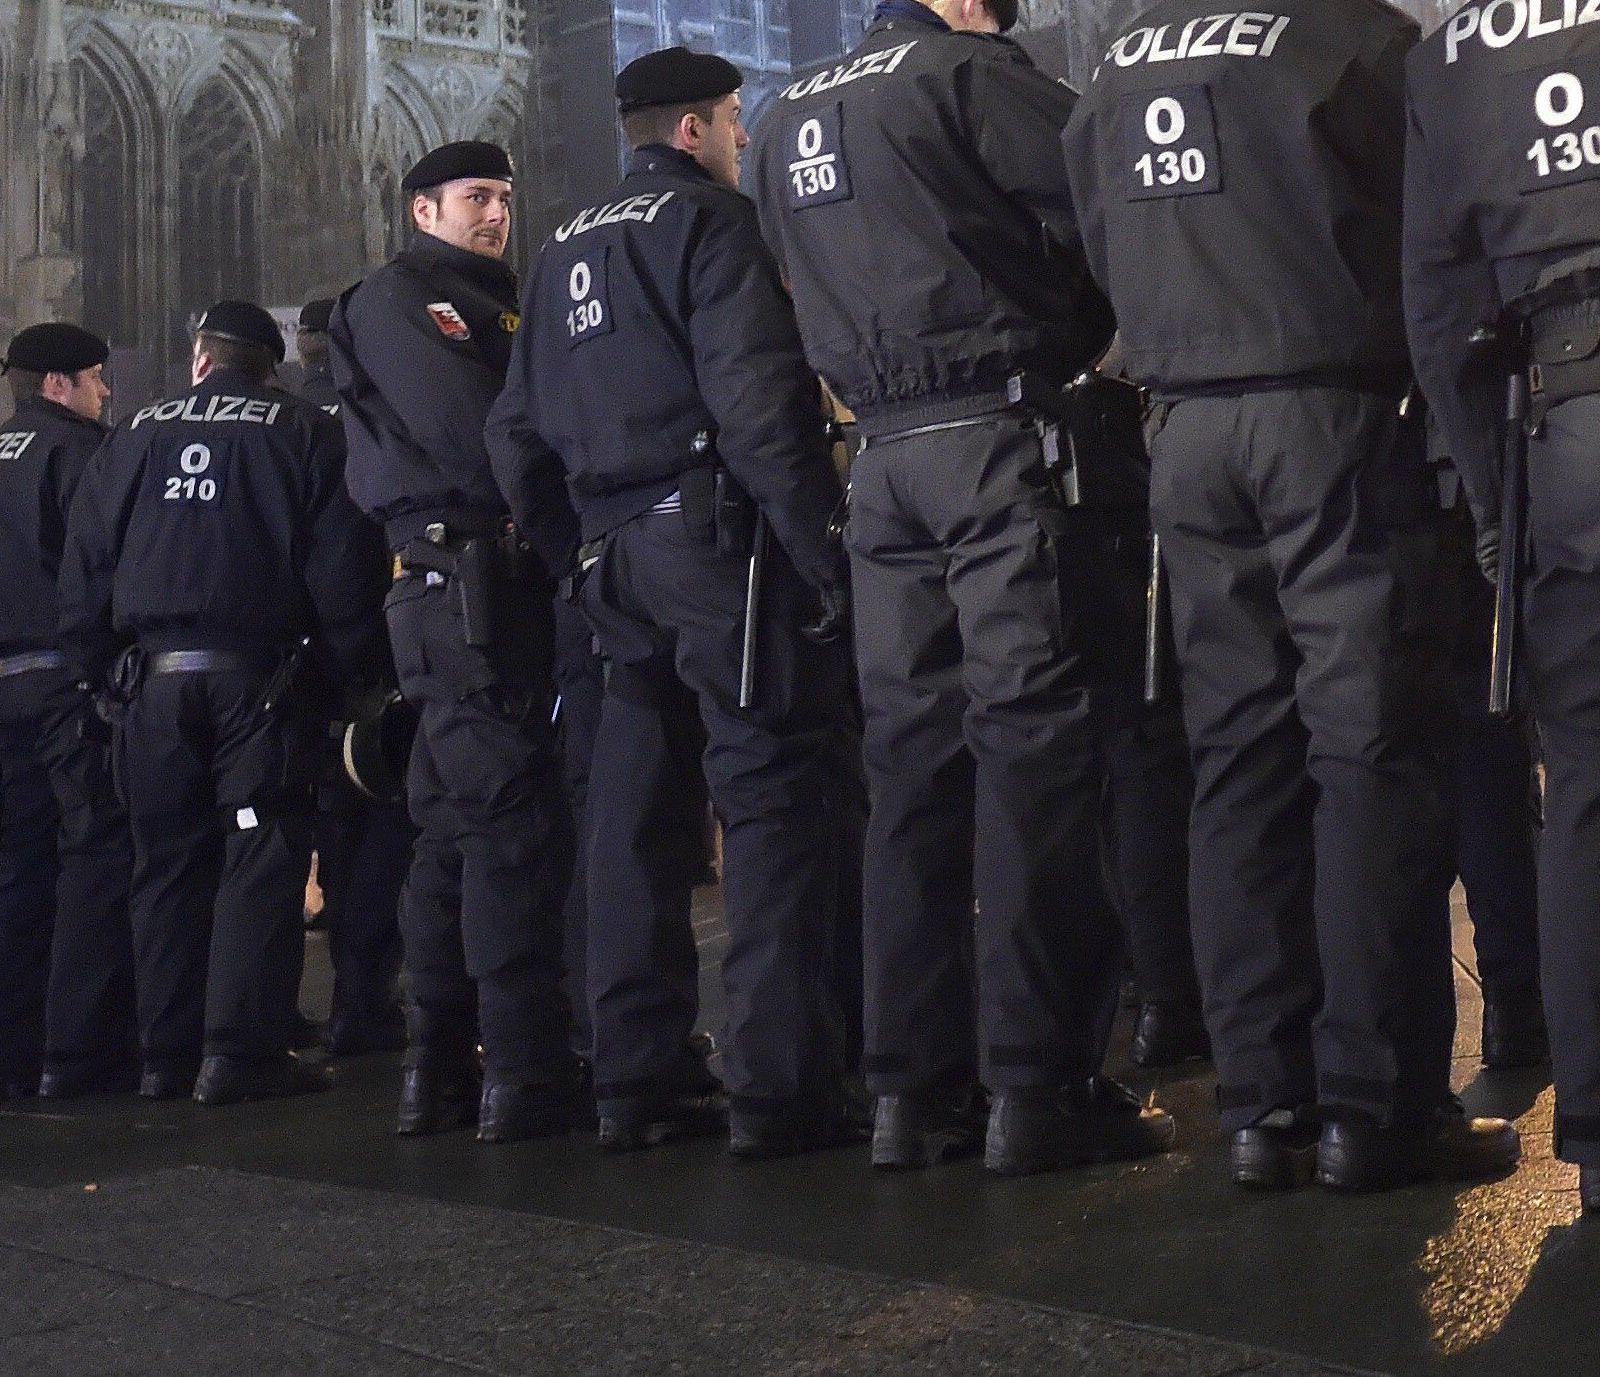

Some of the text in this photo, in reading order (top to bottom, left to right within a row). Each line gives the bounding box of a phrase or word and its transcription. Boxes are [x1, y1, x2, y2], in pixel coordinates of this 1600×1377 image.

[792, 163, 837, 197] 130
[1134, 148, 1206, 187] 130
[566, 299, 603, 337] 130
[131, 395, 281, 429] POLIZEI
[164, 477, 216, 501] 210
